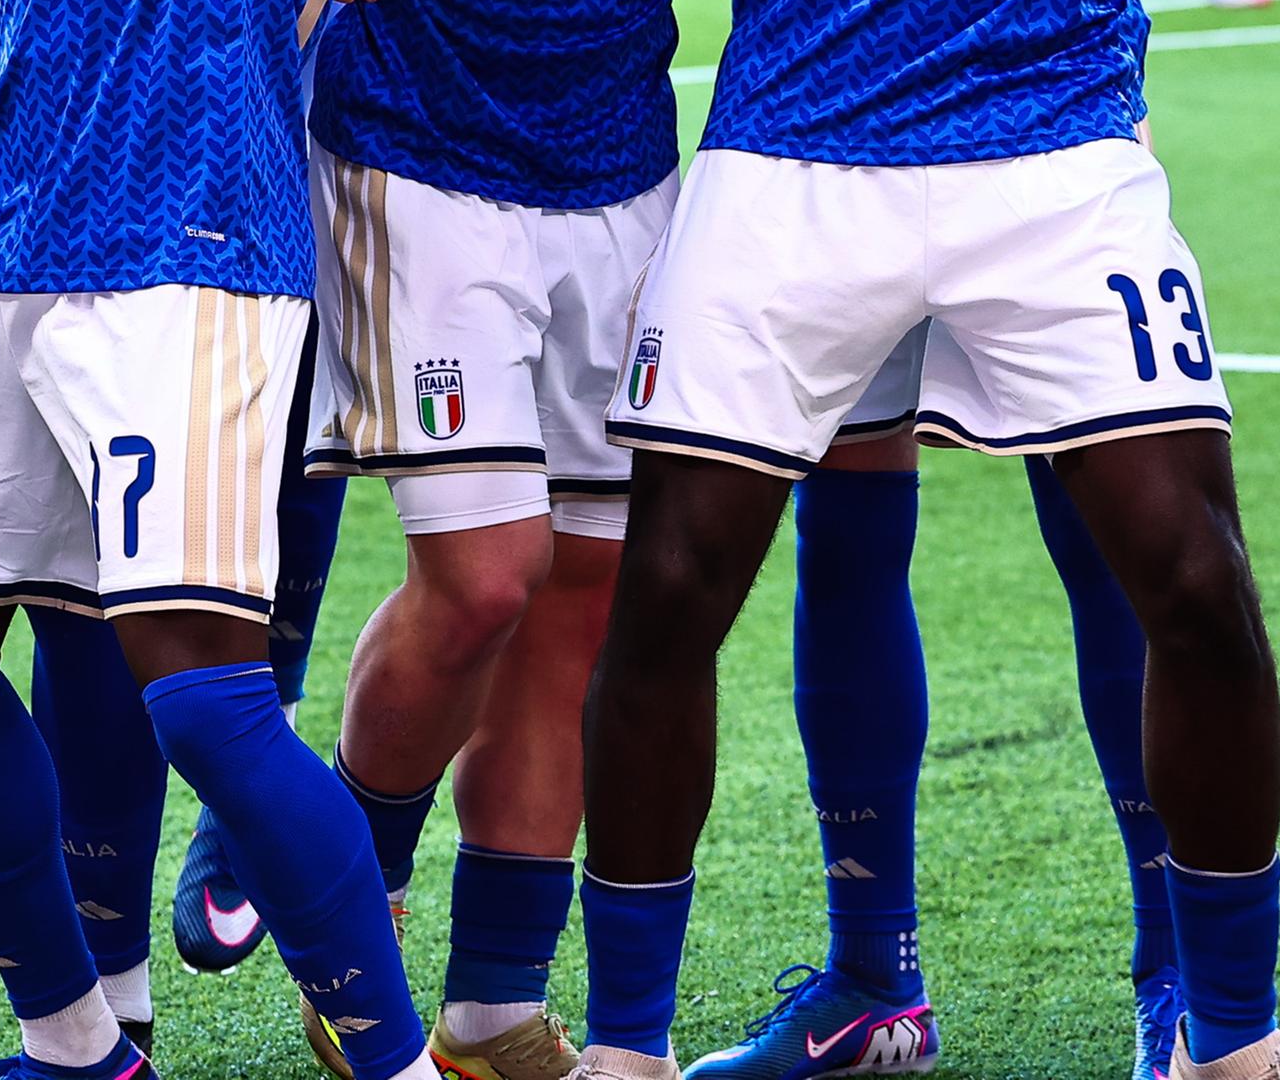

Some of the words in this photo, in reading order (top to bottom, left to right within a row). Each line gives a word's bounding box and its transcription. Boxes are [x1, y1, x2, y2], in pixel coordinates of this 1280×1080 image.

[1106, 268, 1213, 382] 13
[419, 375, 458, 391] ITALIA
[1118, 799, 1157, 813] ITA
[820, 808, 878, 824] ALIA
[60, 837, 117, 857] ALIA
[296, 968, 362, 993] ALIA
